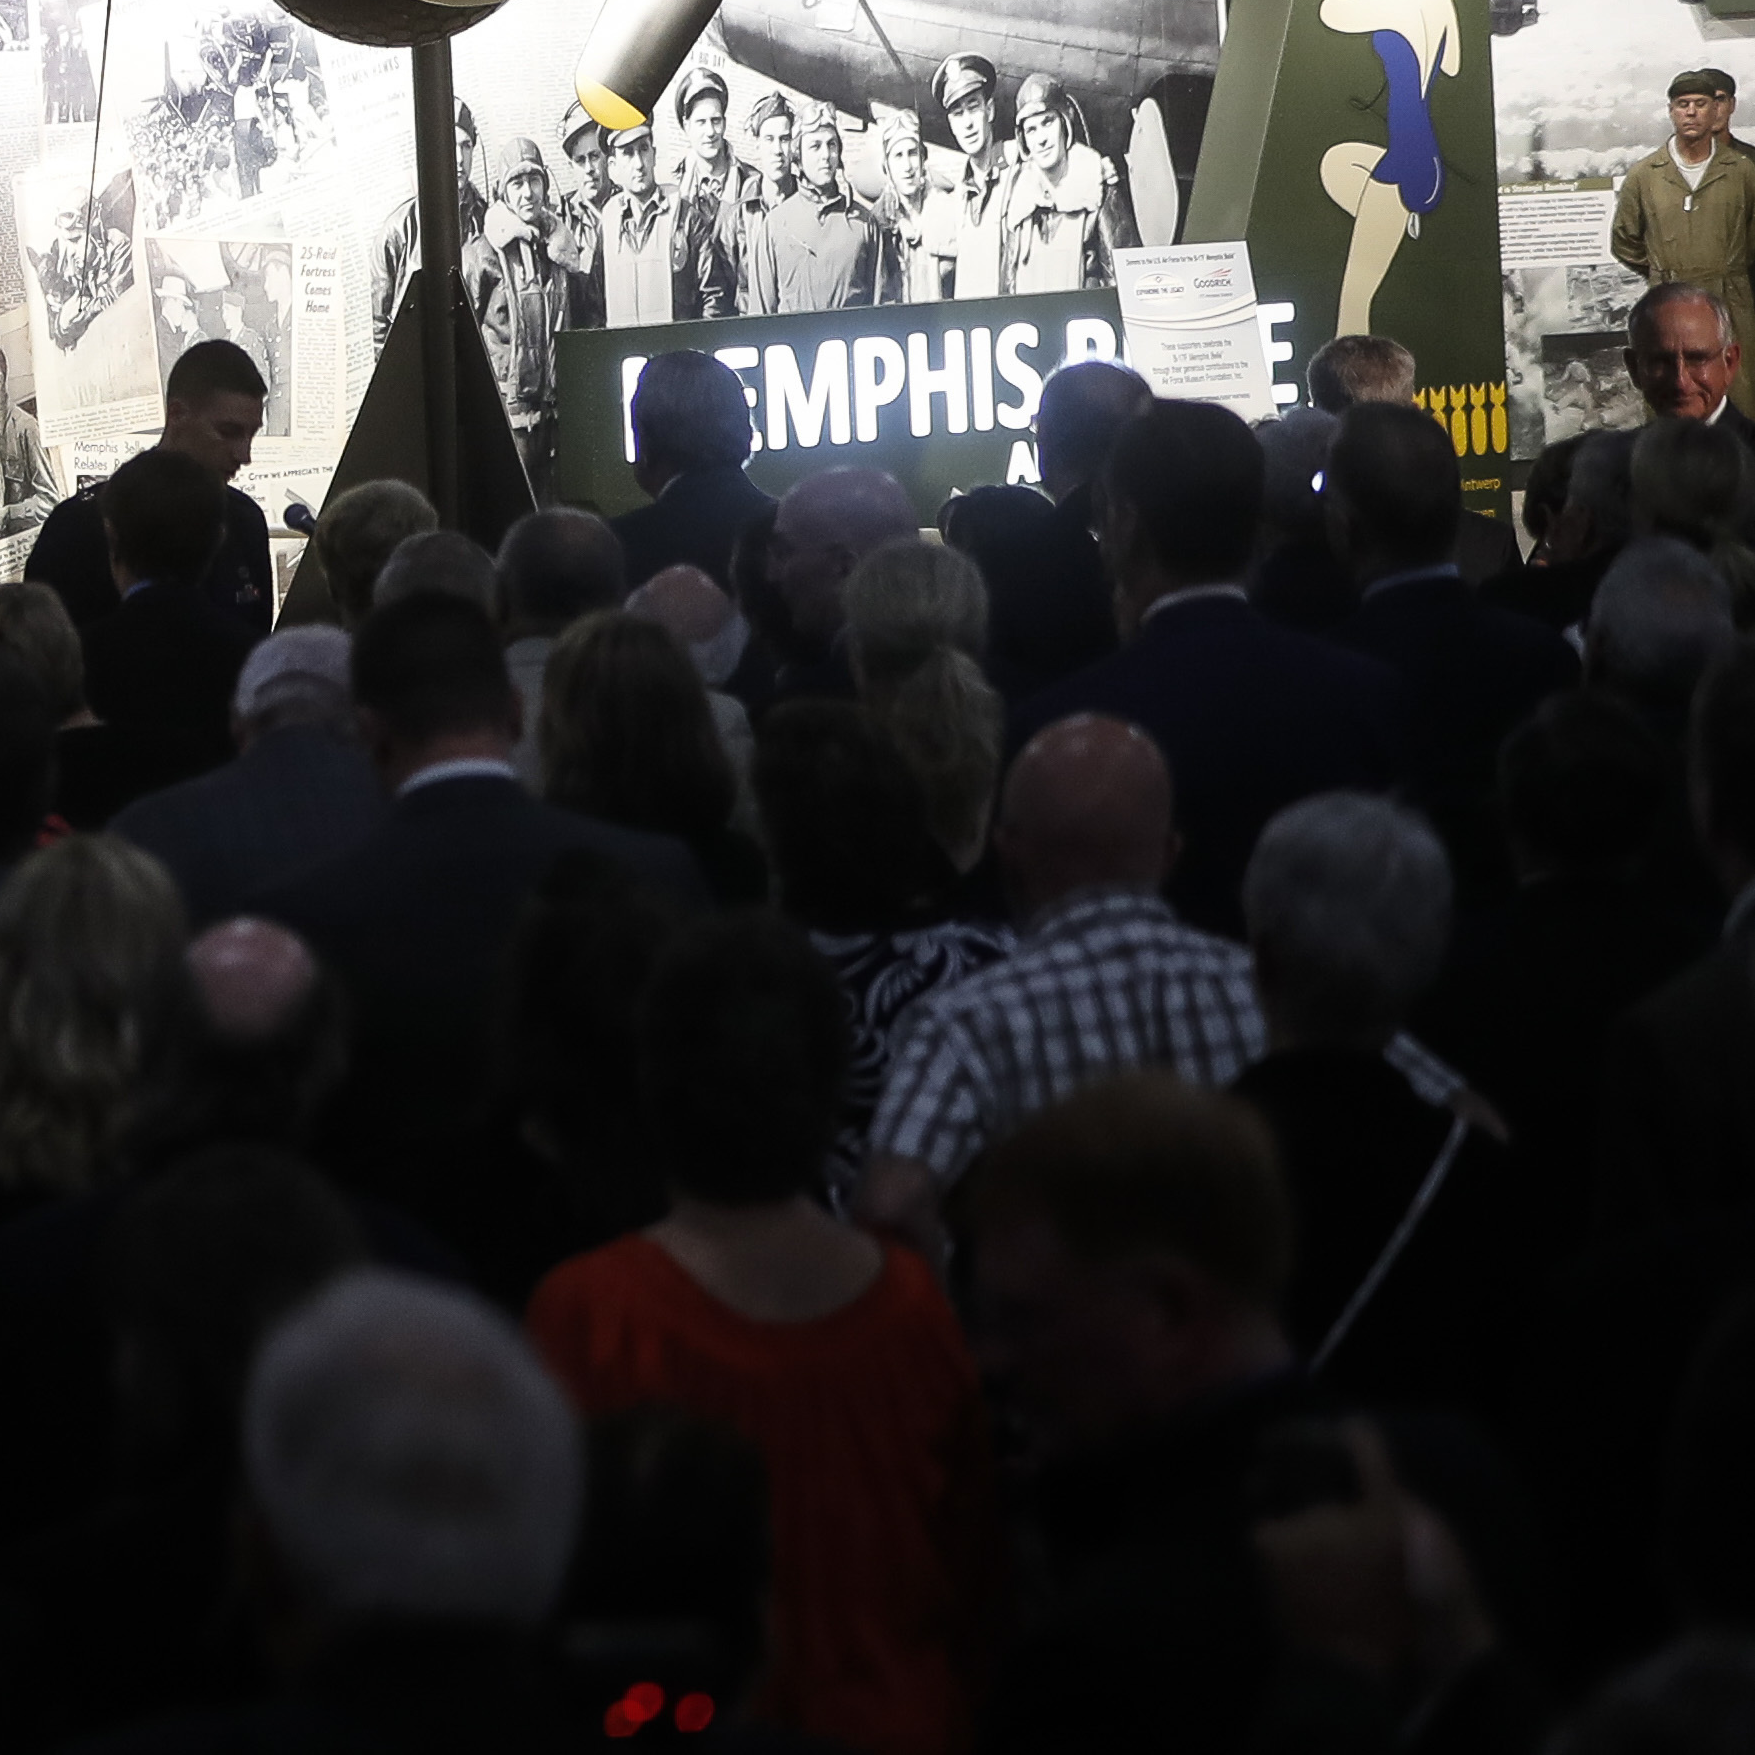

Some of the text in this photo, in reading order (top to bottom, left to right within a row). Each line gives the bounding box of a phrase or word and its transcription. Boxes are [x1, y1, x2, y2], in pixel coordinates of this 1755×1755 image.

[300, 246, 337, 260] 25-Raid
[300, 263, 336, 277] Fortress
[305, 281, 332, 296] Comes
[305, 300, 330, 313] Home
[74, 439, 118, 455] Memphis
[74, 455, 108, 471] Relates
